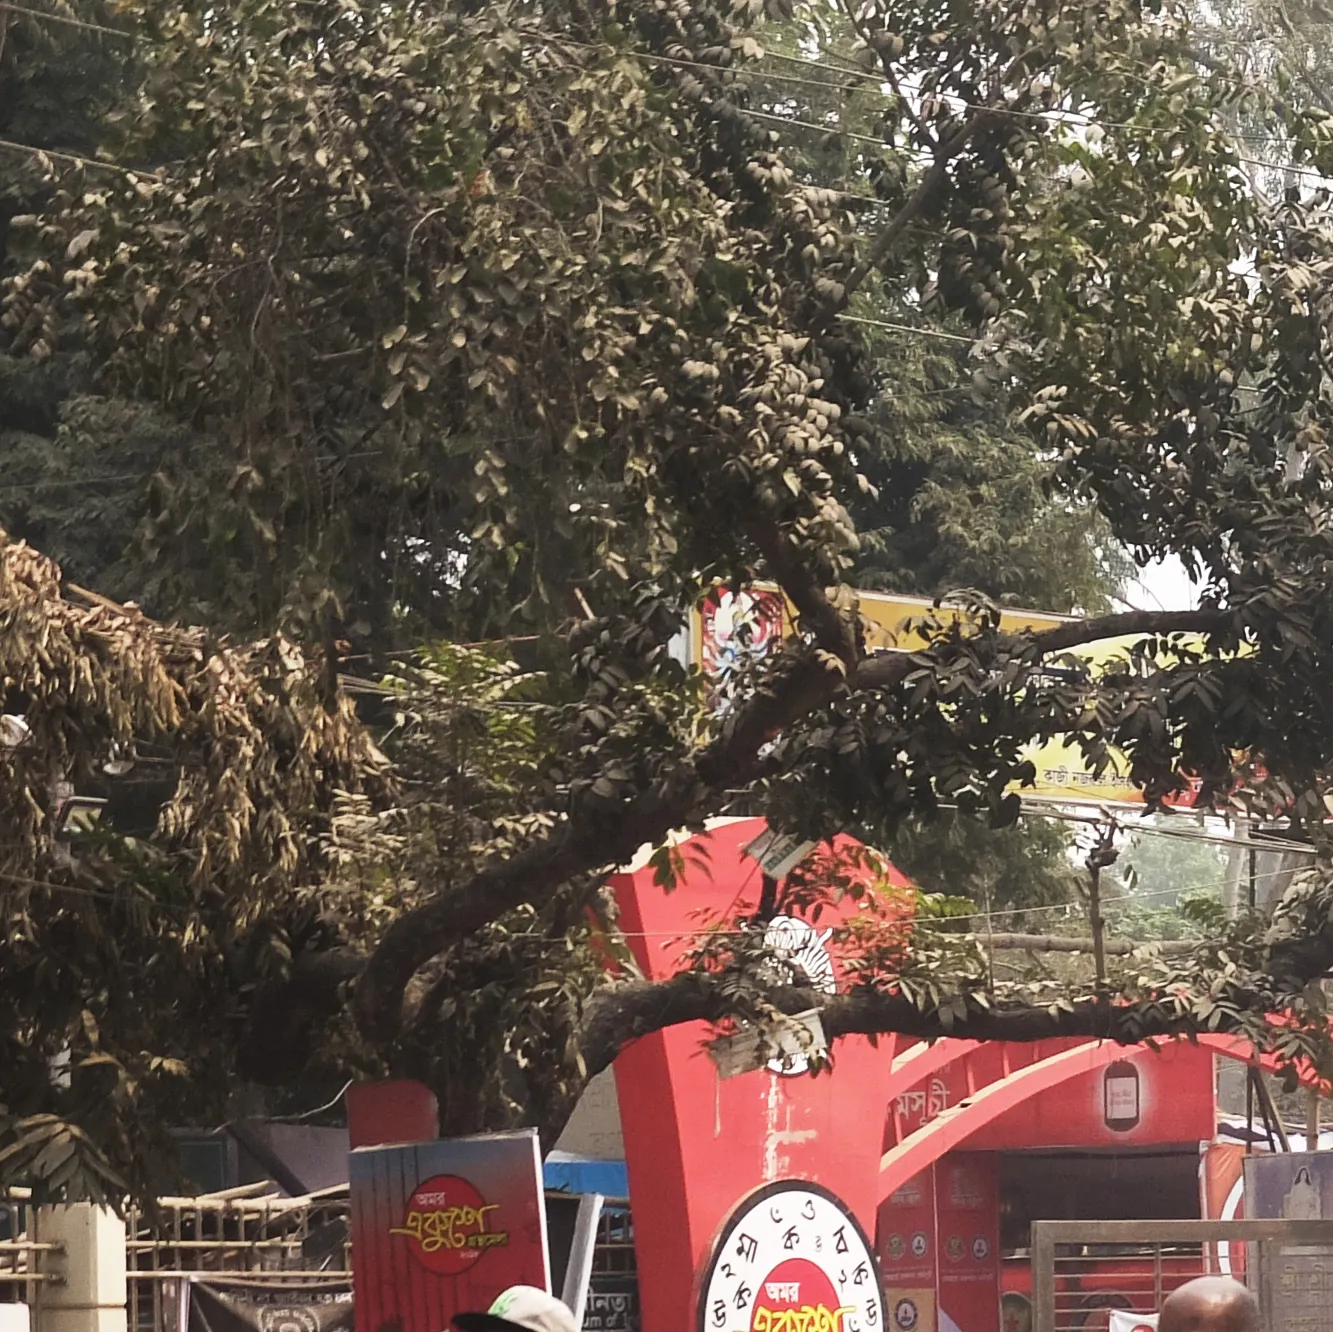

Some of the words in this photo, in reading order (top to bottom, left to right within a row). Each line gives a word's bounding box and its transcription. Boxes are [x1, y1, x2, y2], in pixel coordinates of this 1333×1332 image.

[416, 1192, 446, 1206] অমর
[389, 1205, 499, 1252] একুশে
[765, 1282, 799, 1303] অমর
